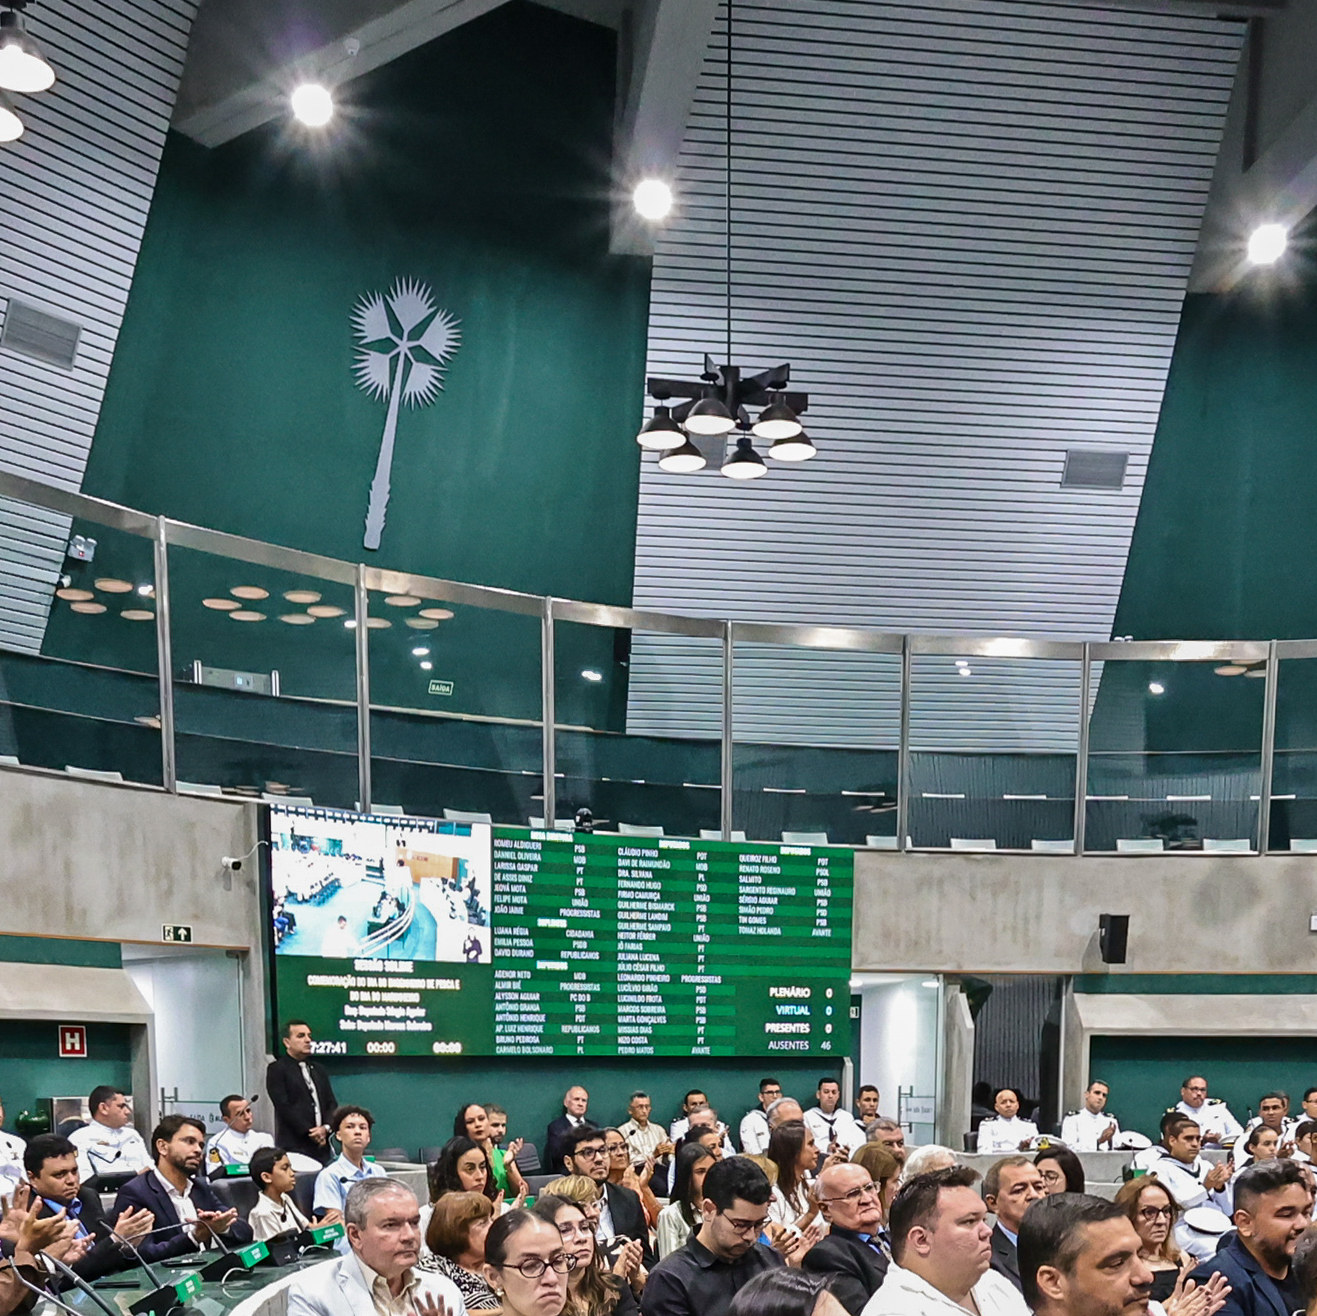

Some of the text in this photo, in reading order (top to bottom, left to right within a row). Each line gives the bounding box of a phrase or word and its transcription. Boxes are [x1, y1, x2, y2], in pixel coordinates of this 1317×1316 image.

[576, 867, 584, 875] PT
[698, 873, 705, 881] PL
[576, 878, 583, 886] PT
[698, 925, 705, 933] PT
[698, 944, 705, 952] PT
[698, 955, 705, 963] PT
[698, 965, 705, 973] PT
[769, 986, 833, 999] PLENÁRIO 0
[570, 993, 578, 1002] PC
[775, 1005, 833, 1016] VIRTUAL 0
[765, 1022, 832, 1034] PRESENTES 0
[65, 1032, 80, 1050] H
[577, 1036, 584, 1044] PT
[309, 1042, 347, 1054] 7:27:41
[366, 1041, 396, 1054] 00:00
[768, 1041, 831, 1050] AUSENTES 46
[577, 1046, 584, 1054] PL
